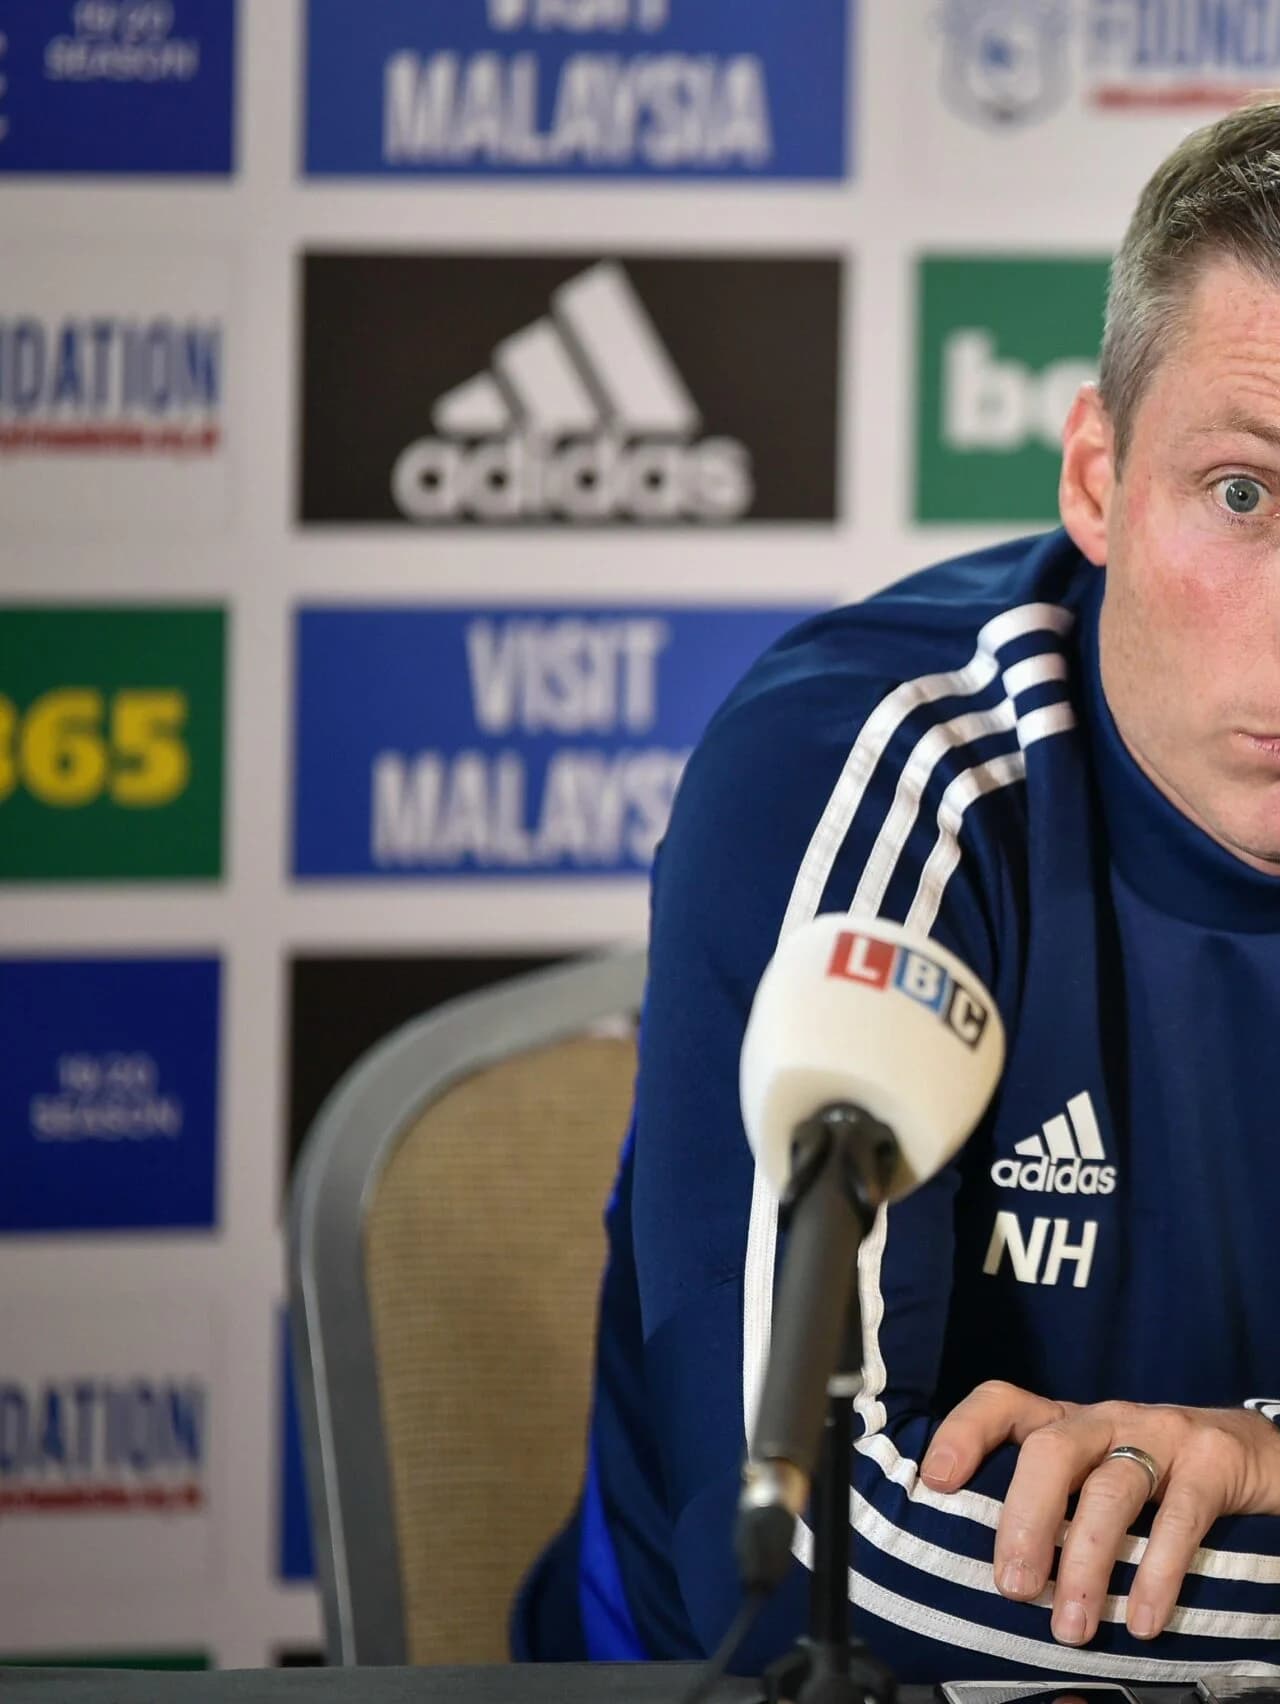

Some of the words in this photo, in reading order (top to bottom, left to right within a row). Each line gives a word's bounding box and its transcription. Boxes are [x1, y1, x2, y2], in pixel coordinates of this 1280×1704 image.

[384, 52, 770, 167] MALAYSIA
[0, 318, 222, 412] DATION
[392, 434, 753, 522] adidas
[466, 618, 668, 735] VISIT
[0, 686, 190, 808] 65
[838, 934, 987, 1048] LBC
[990, 1157, 1117, 1195] adidas
[983, 1210, 1098, 1289] NH
